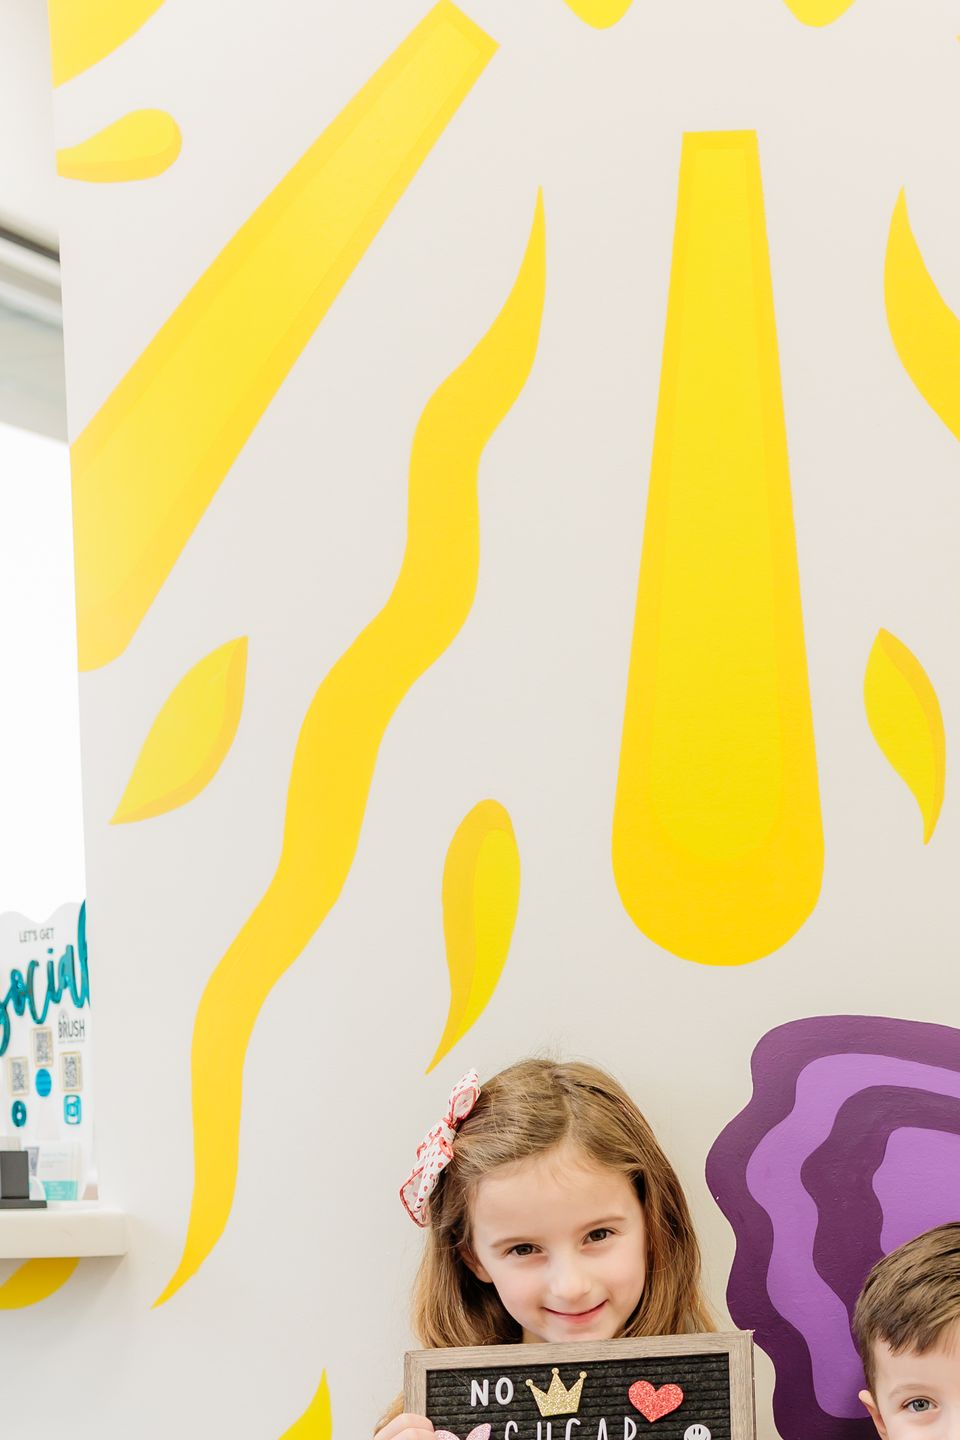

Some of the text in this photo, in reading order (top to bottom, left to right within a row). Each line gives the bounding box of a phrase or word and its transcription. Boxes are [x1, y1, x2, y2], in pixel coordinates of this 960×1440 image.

[40, 928, 54, 940] GET
[58, 1018, 85, 1038] BRUSH
[470, 1377, 514, 1407] NO
